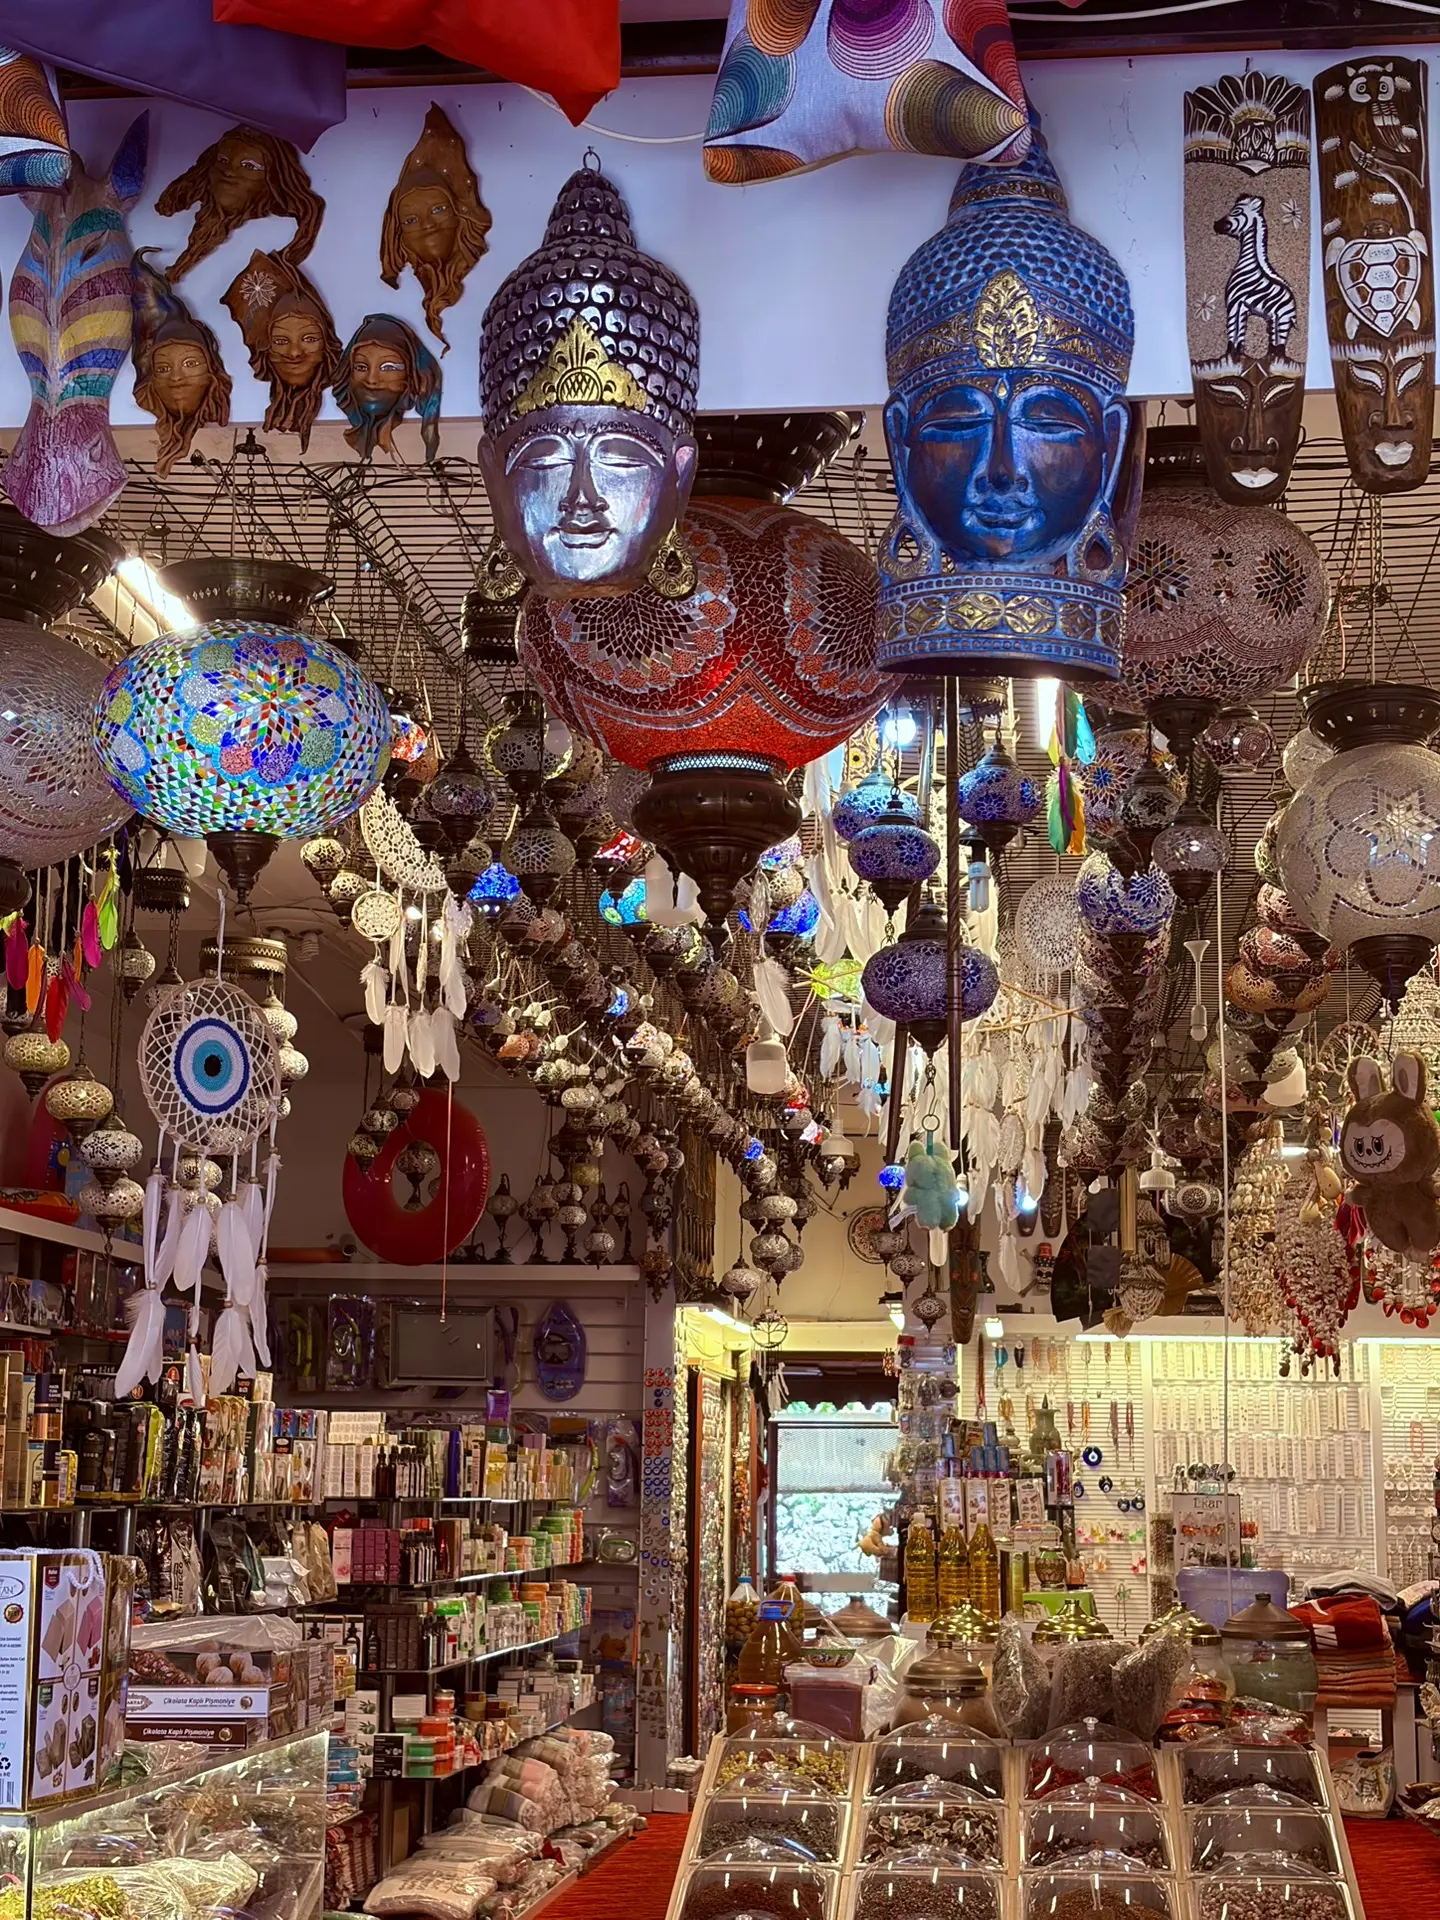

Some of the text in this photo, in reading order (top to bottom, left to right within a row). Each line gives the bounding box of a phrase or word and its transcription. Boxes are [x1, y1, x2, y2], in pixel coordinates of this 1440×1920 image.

[188, 1697, 204, 1705] Kaplı
[205, 1697, 235, 1705] Pişmaniye
[142, 1728, 215, 1736] Çikolata Kaplı Pişmaniye
